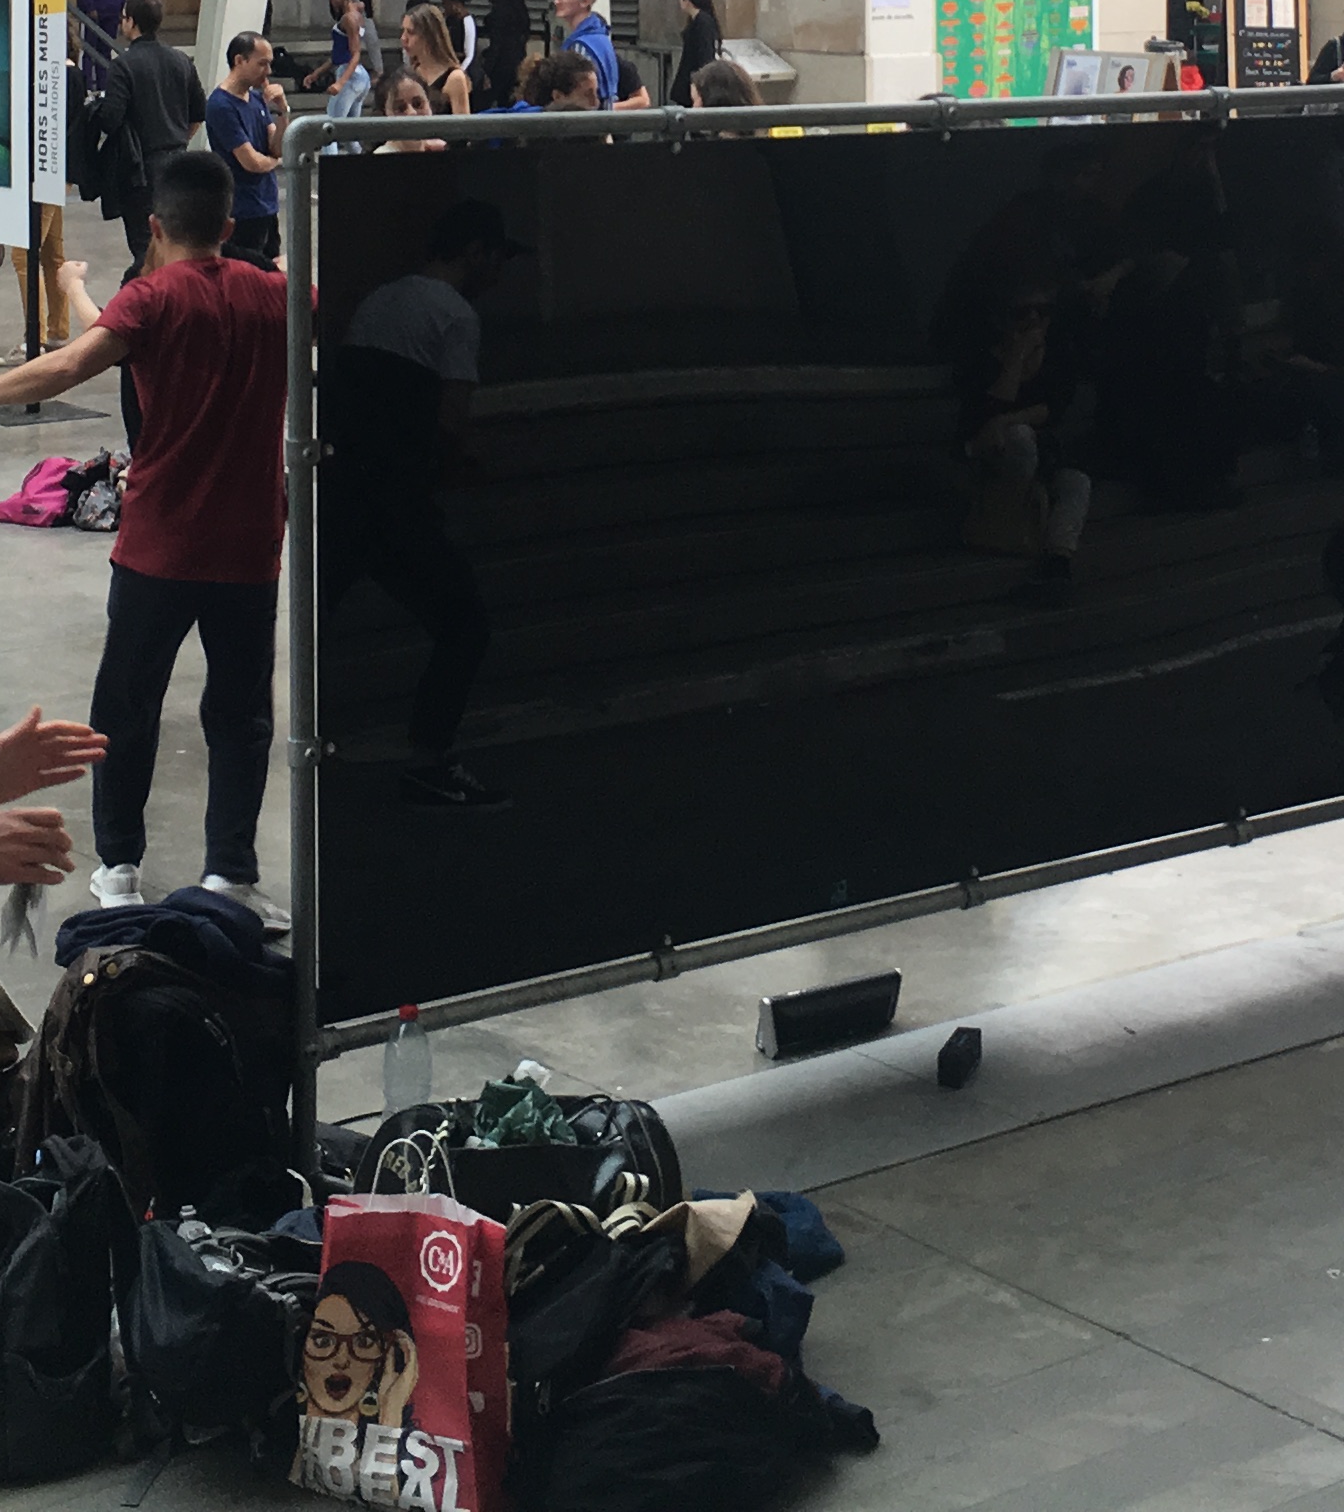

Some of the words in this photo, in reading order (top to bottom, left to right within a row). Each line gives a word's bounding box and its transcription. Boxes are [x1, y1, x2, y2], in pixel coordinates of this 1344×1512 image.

[39, 3, 47, 61] MURS
[39, 69, 47, 107] LES
[39, 116, 47, 172] HORS
